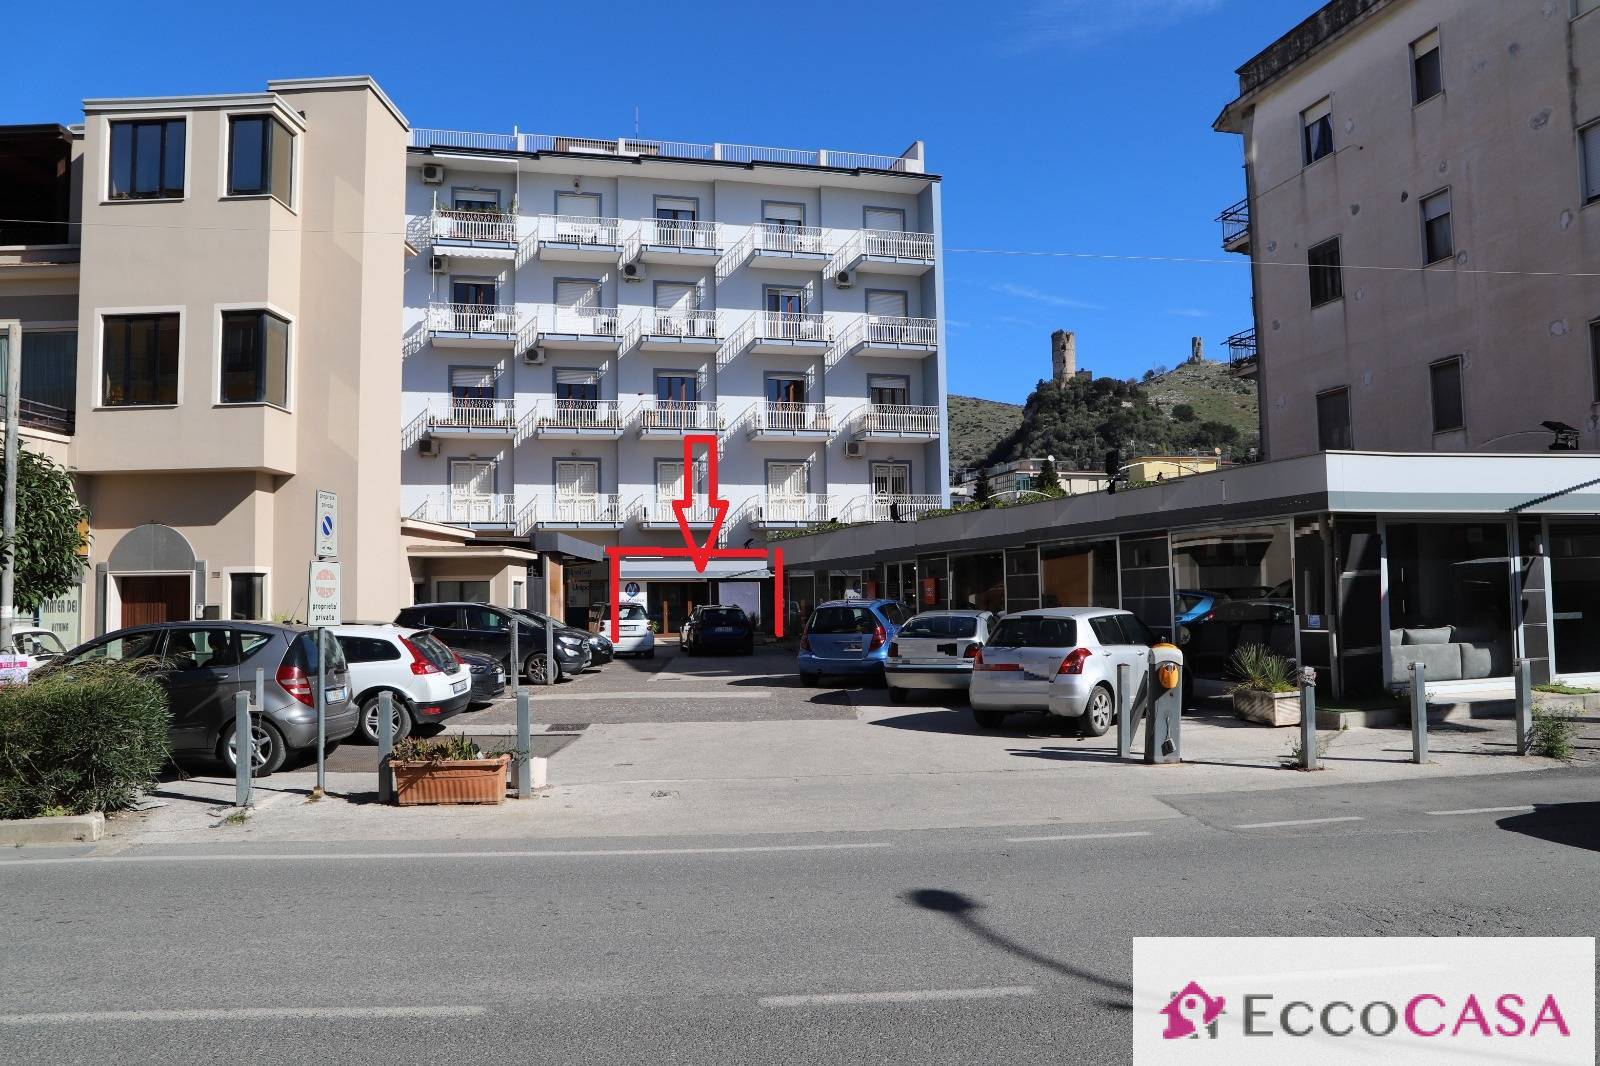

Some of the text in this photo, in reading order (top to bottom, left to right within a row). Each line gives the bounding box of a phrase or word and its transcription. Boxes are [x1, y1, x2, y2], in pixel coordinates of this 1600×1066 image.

[43, 599, 78, 614] MATER DEI
[315, 612, 335, 621] privata
